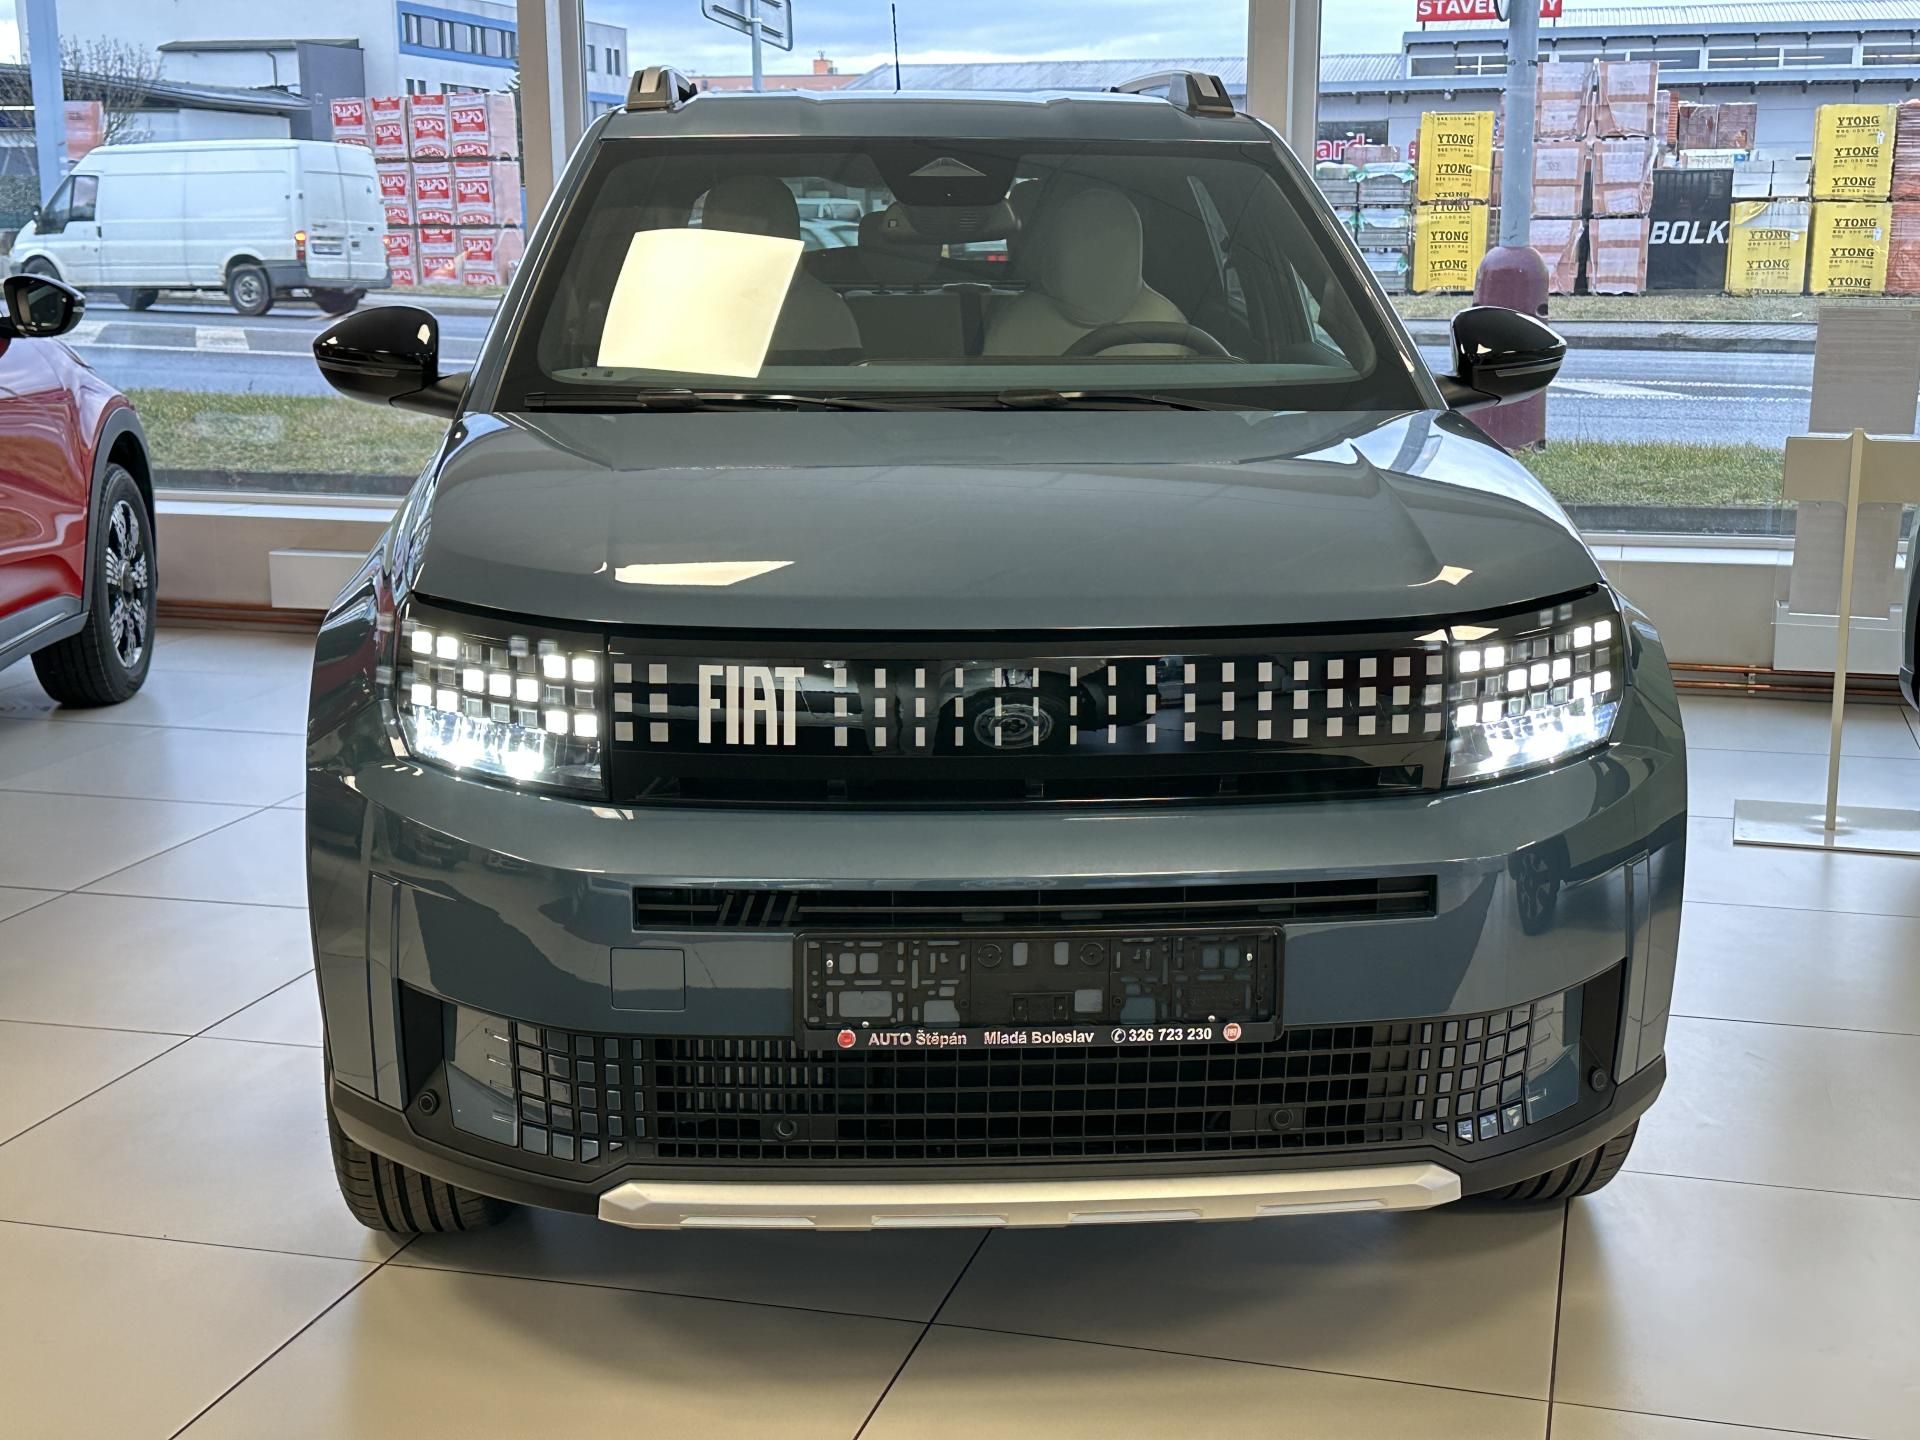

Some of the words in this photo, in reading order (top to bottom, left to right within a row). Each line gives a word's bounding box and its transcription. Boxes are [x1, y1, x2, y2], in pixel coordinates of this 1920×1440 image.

[1837, 115, 1880, 126] YTONG
[1438, 133, 1474, 145] YTONG
[1834, 146, 1879, 157] YTONG
[1437, 163, 1472, 175] YTONG
[1832, 176, 1876, 186] YTONG
[1834, 218, 1877, 227] YTONG
[1430, 231, 1469, 241] YTONG
[1649, 220, 1730, 245] BOLK
[1749, 229, 1790, 240] YTONG
[1830, 247, 1875, 258] YTONG
[1430, 260, 1468, 270] YTONG
[1746, 259, 1790, 269] YTONG
[1828, 276, 1871, 287] YTONG
[698, 664, 805, 746] FIAT
[868, 1032, 912, 1046] AUTO
[915, 1030, 967, 1048] Štěpán
[983, 1031, 1027, 1045] Mladá
[1031, 1029, 1095, 1044] Boleslav
[1128, 1029, 1154, 1042] 326
[1158, 1028, 1183, 1041] 723
[1187, 1027, 1212, 1041] 230
